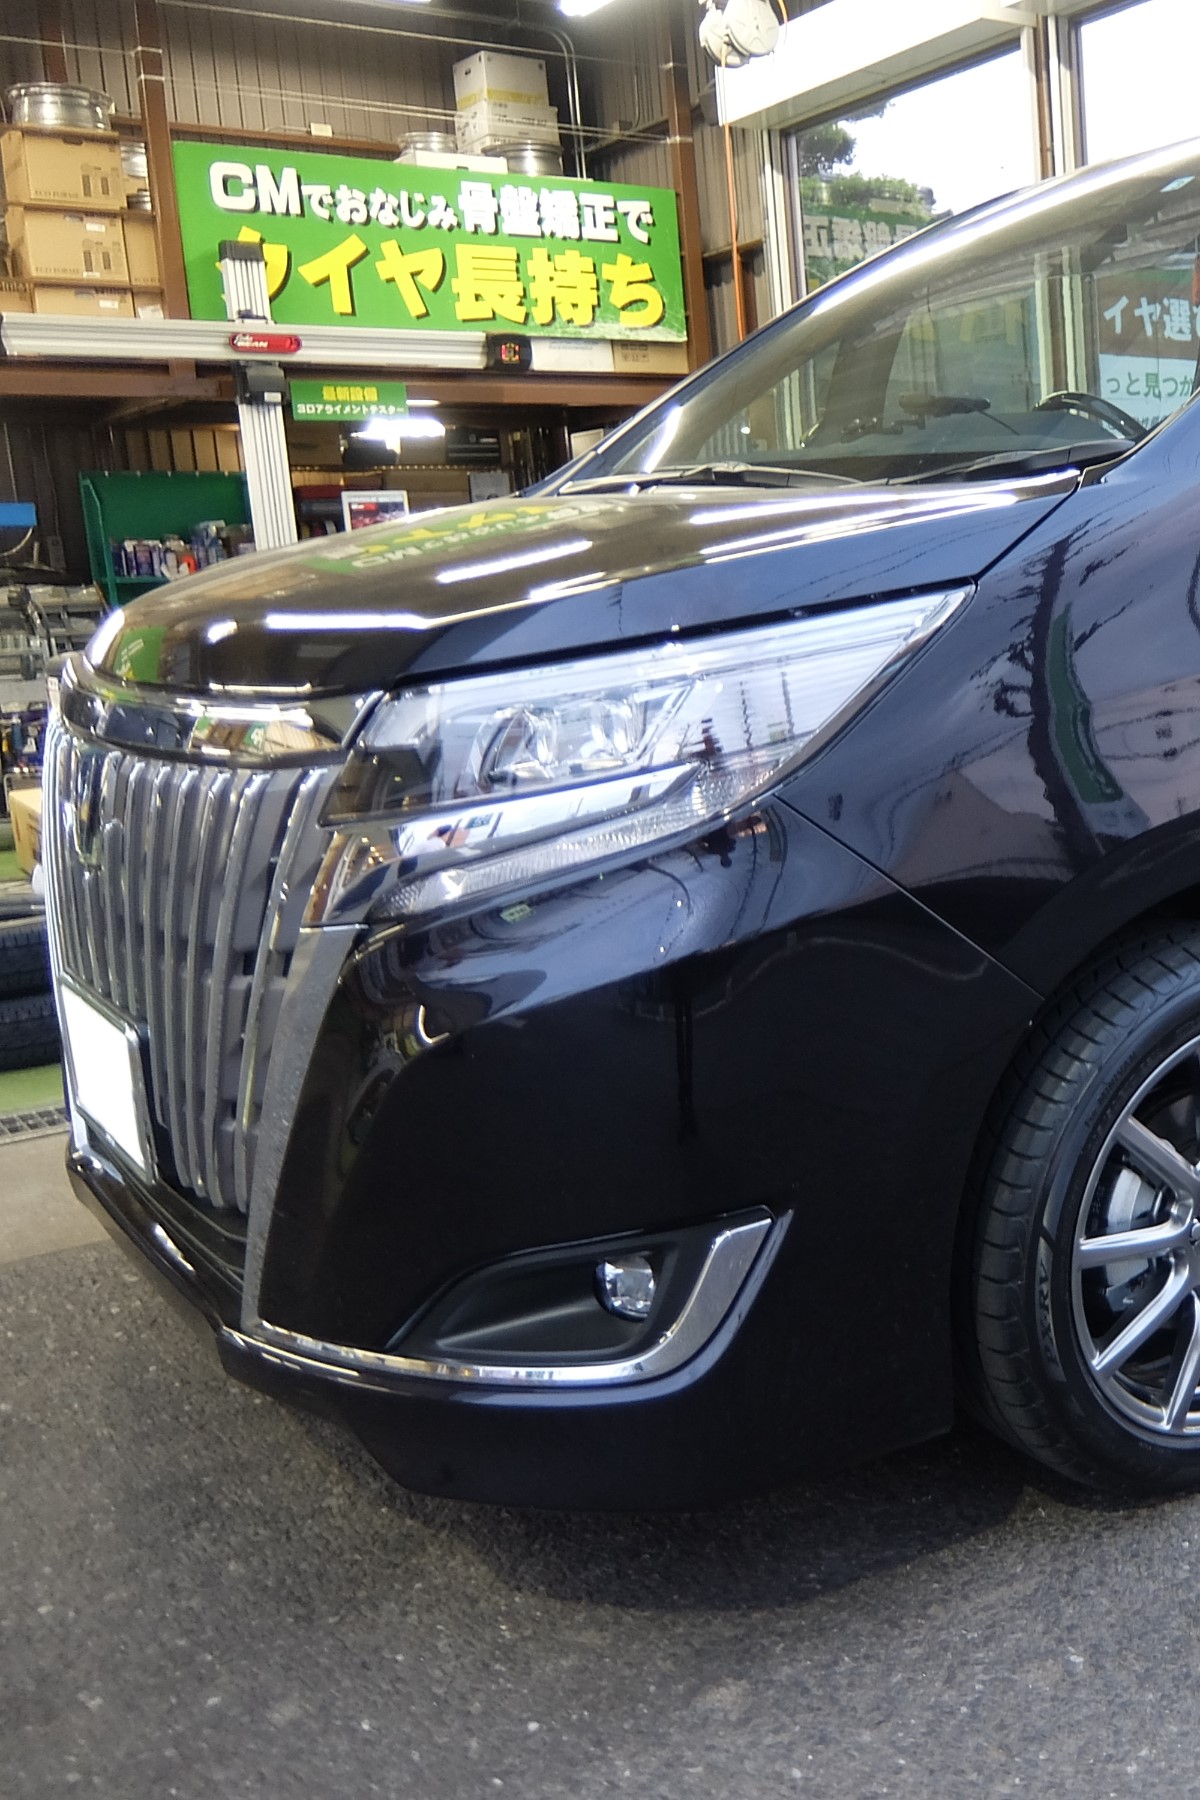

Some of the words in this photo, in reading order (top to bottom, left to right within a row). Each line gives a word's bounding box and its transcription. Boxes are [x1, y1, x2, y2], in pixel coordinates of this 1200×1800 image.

[209, 161, 655, 243] CMでおなじみ骨盤矯正で
